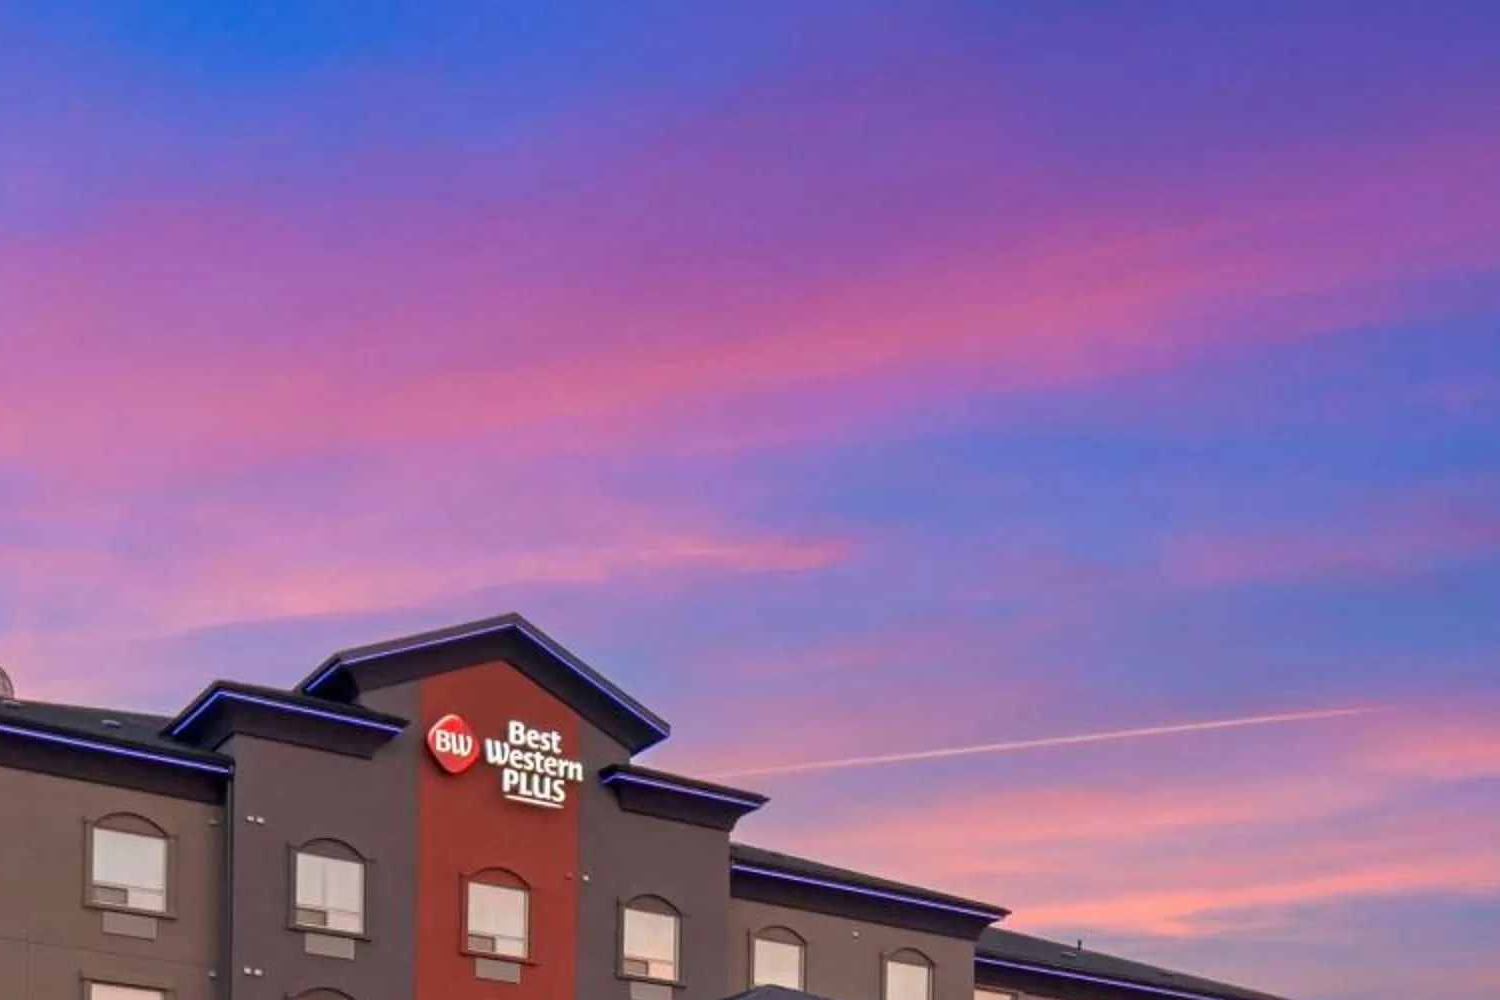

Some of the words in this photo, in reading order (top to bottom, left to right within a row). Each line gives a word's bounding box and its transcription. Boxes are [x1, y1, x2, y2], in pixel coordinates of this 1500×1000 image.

[435, 729, 473, 757] BW
[508, 720, 562, 754] Best
[484, 738, 583, 781] Western
[502, 767, 566, 802] PLUS
